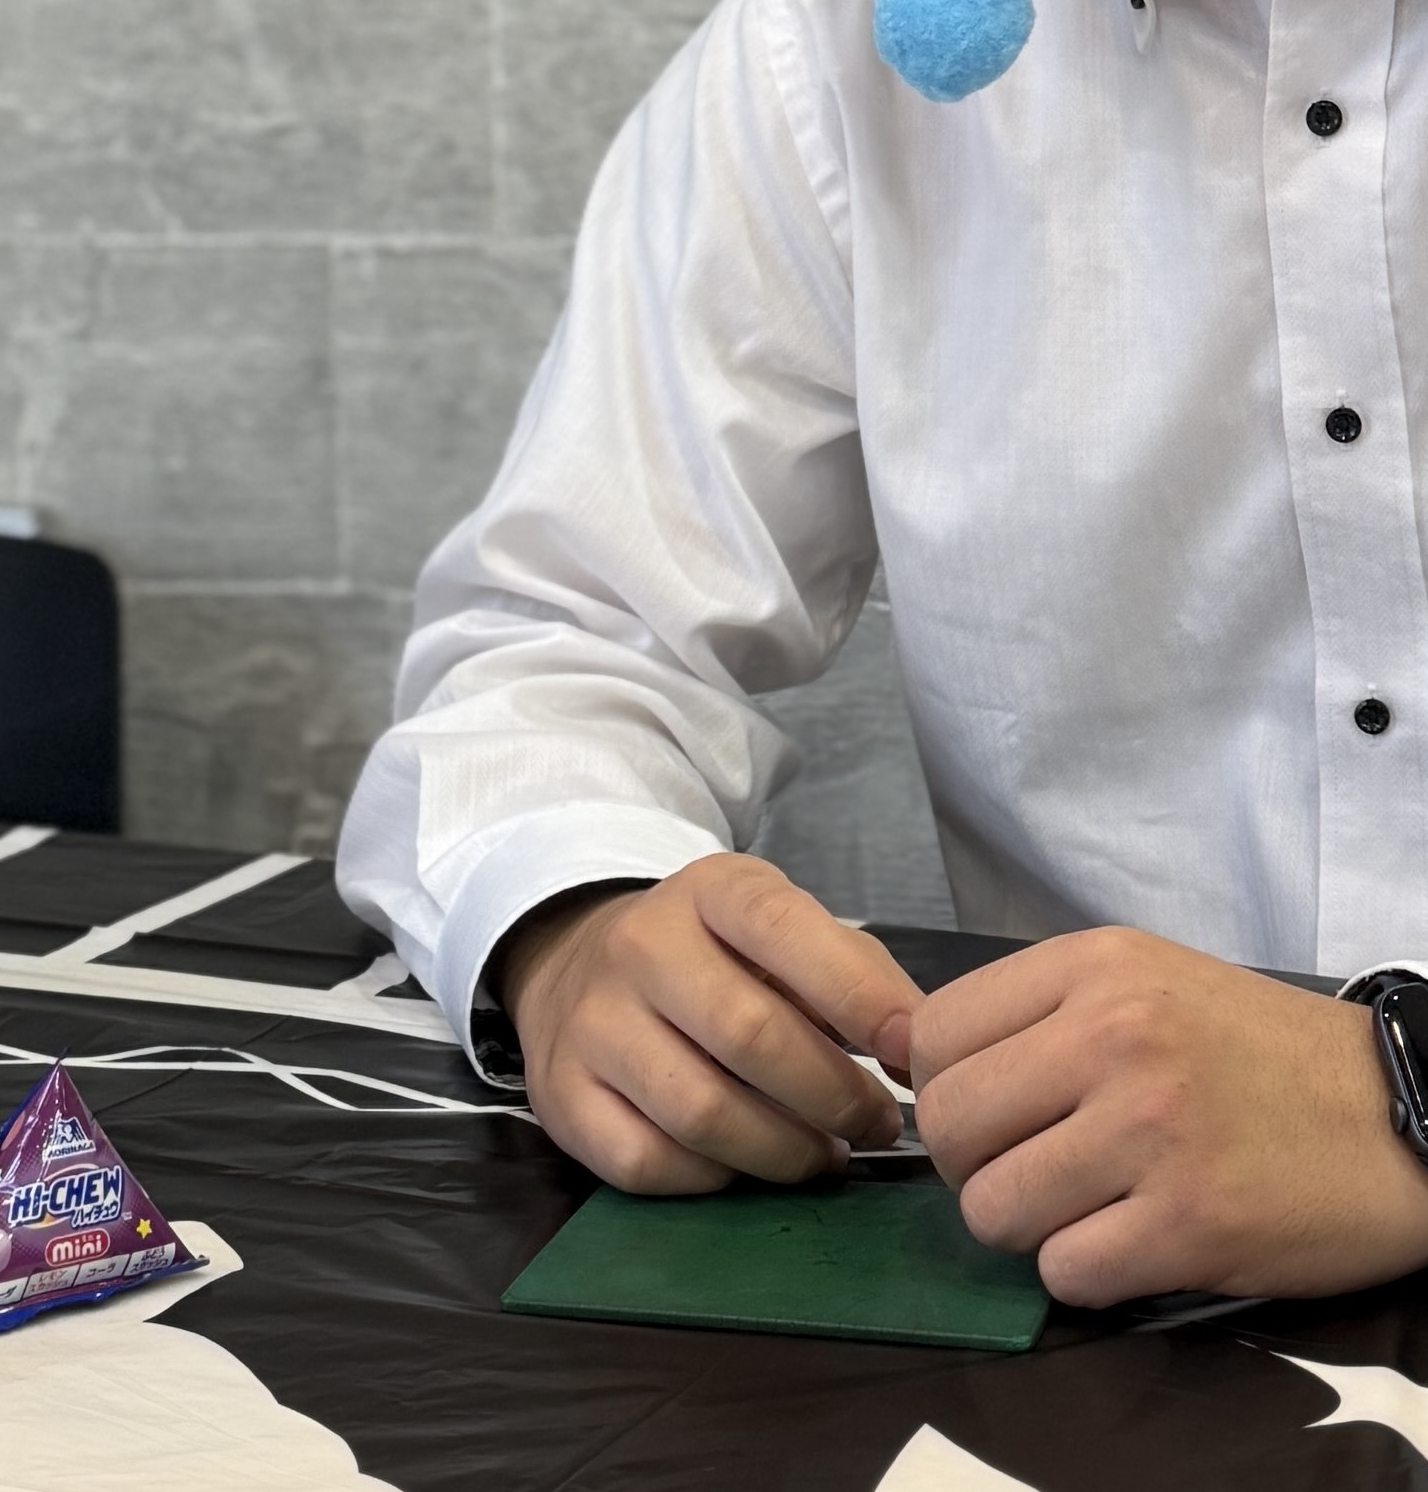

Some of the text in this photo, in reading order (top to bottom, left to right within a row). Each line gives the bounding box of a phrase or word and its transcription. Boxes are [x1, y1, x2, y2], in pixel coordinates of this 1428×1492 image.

[8, 1165, 122, 1223] HI-CHEW
[52, 1234, 103, 1263] mini
[85, 1262, 118, 1278] コーラ
